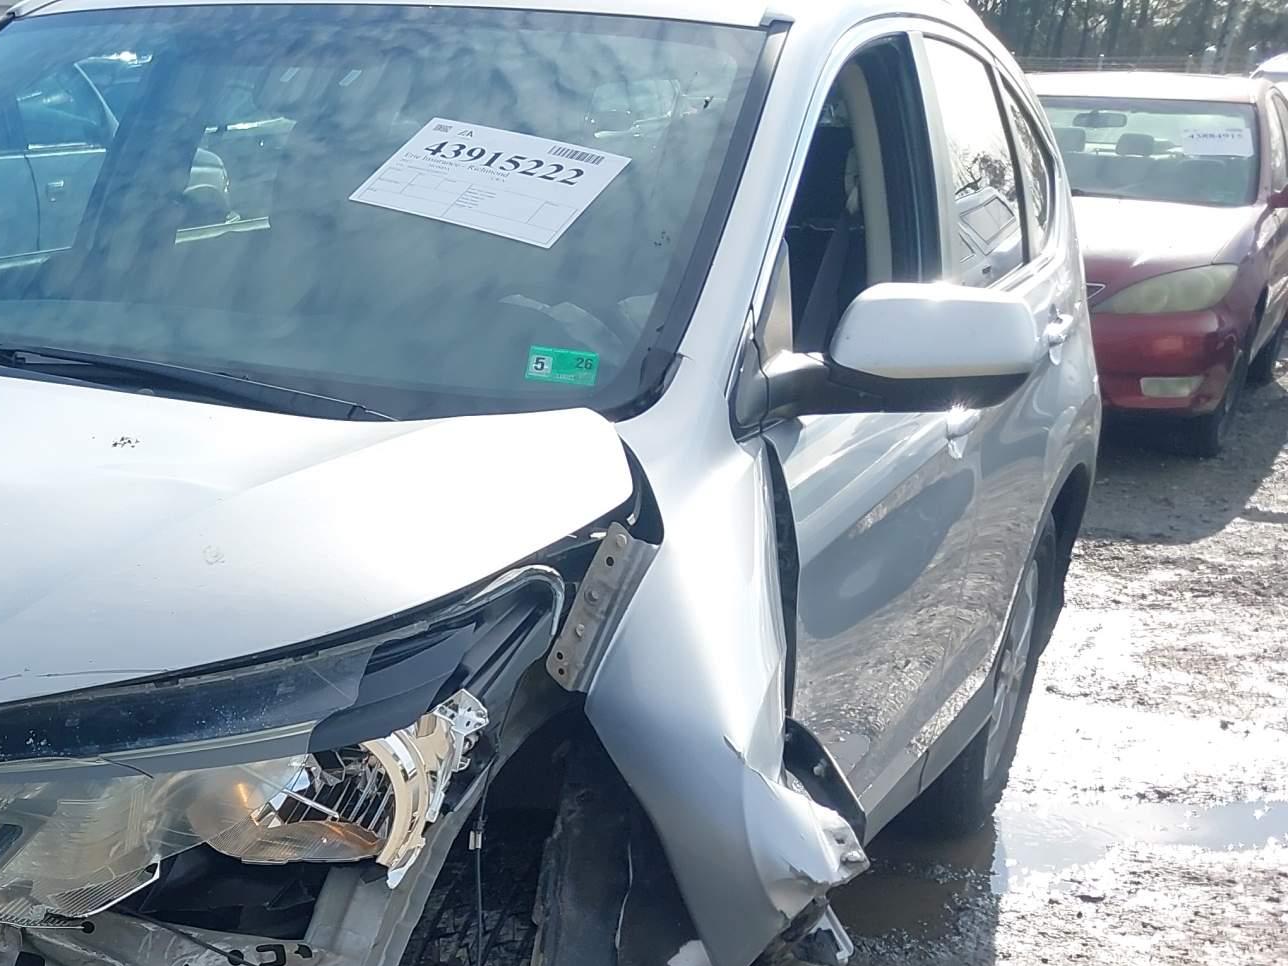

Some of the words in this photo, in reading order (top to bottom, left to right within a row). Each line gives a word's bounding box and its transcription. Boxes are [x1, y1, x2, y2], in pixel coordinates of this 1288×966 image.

[423, 141, 585, 186] 43915222
[533, 356, 546, 371] 5
[575, 356, 594, 370] 26
